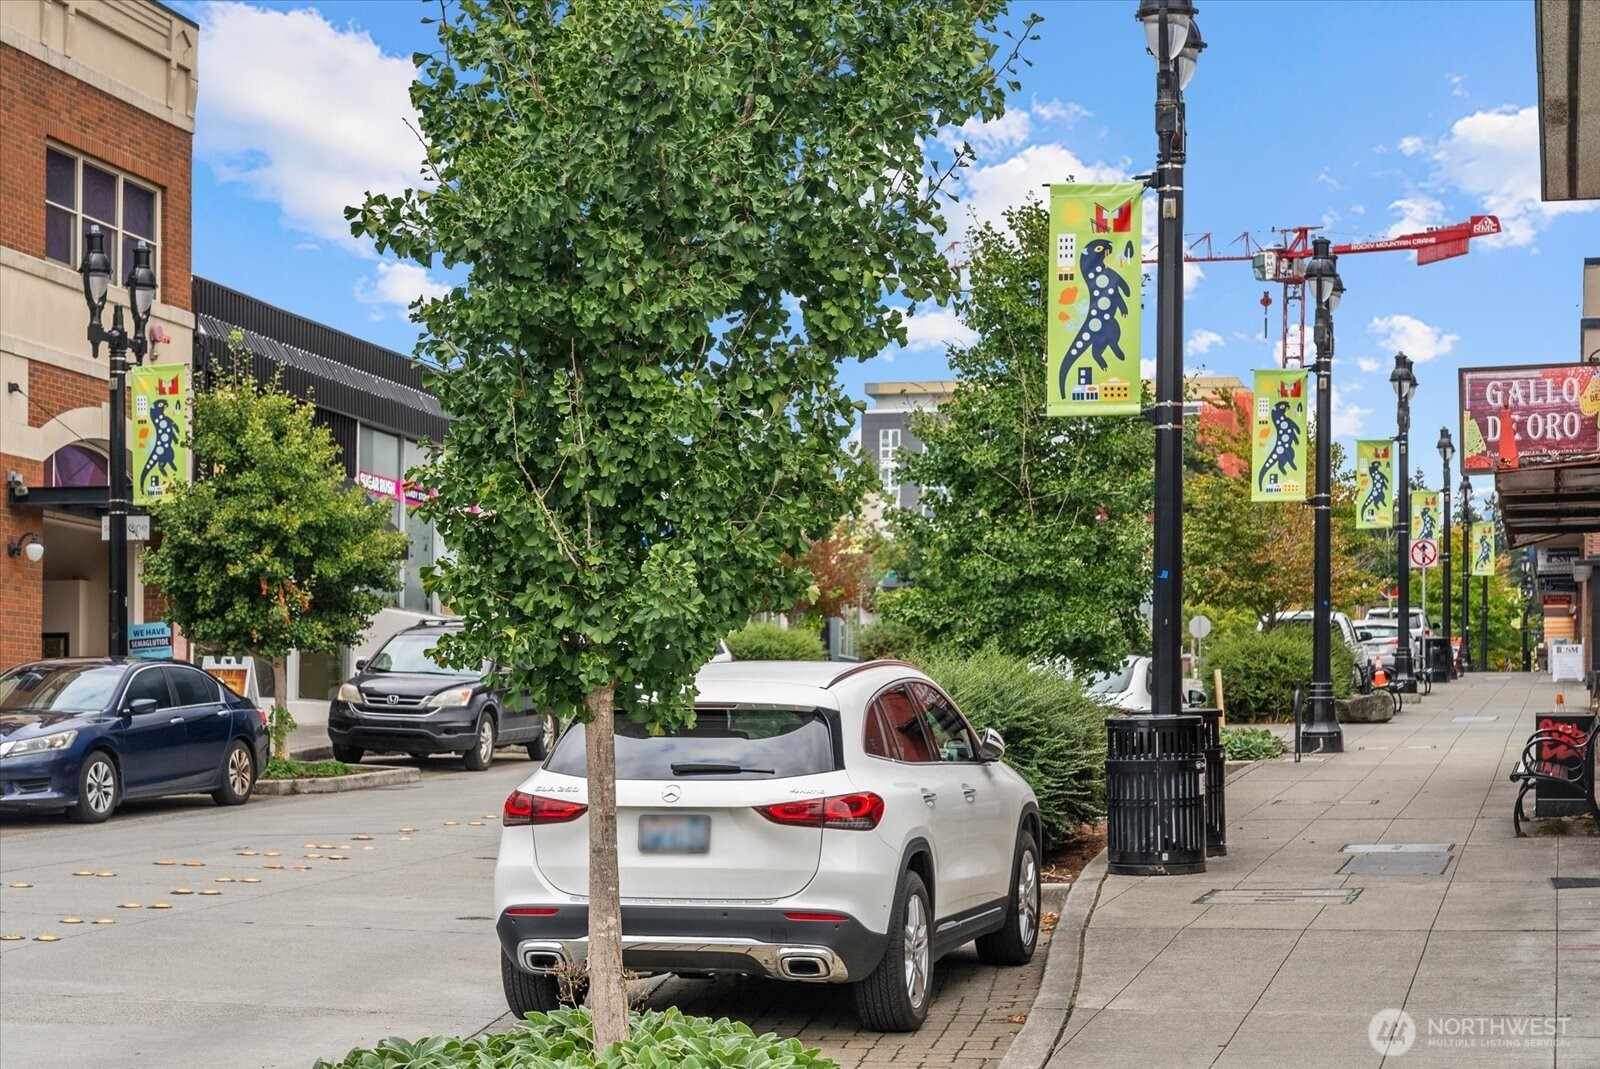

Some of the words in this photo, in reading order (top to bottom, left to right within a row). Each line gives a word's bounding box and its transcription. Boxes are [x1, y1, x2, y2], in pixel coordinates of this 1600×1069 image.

[1473, 223, 1498, 233] RMC
[1376, 239, 1411, 248] MOUNTAIN
[1412, 237, 1436, 245] CRANE
[1486, 377, 1579, 407] GALLO
[1526, 412, 1579, 440] ORO
[360, 471, 380, 492] SUGAR
[380, 478, 396, 496] RUSH
[145, 627, 166, 636] HAVE
[131, 638, 169, 648] SEMAGLUTIDE
